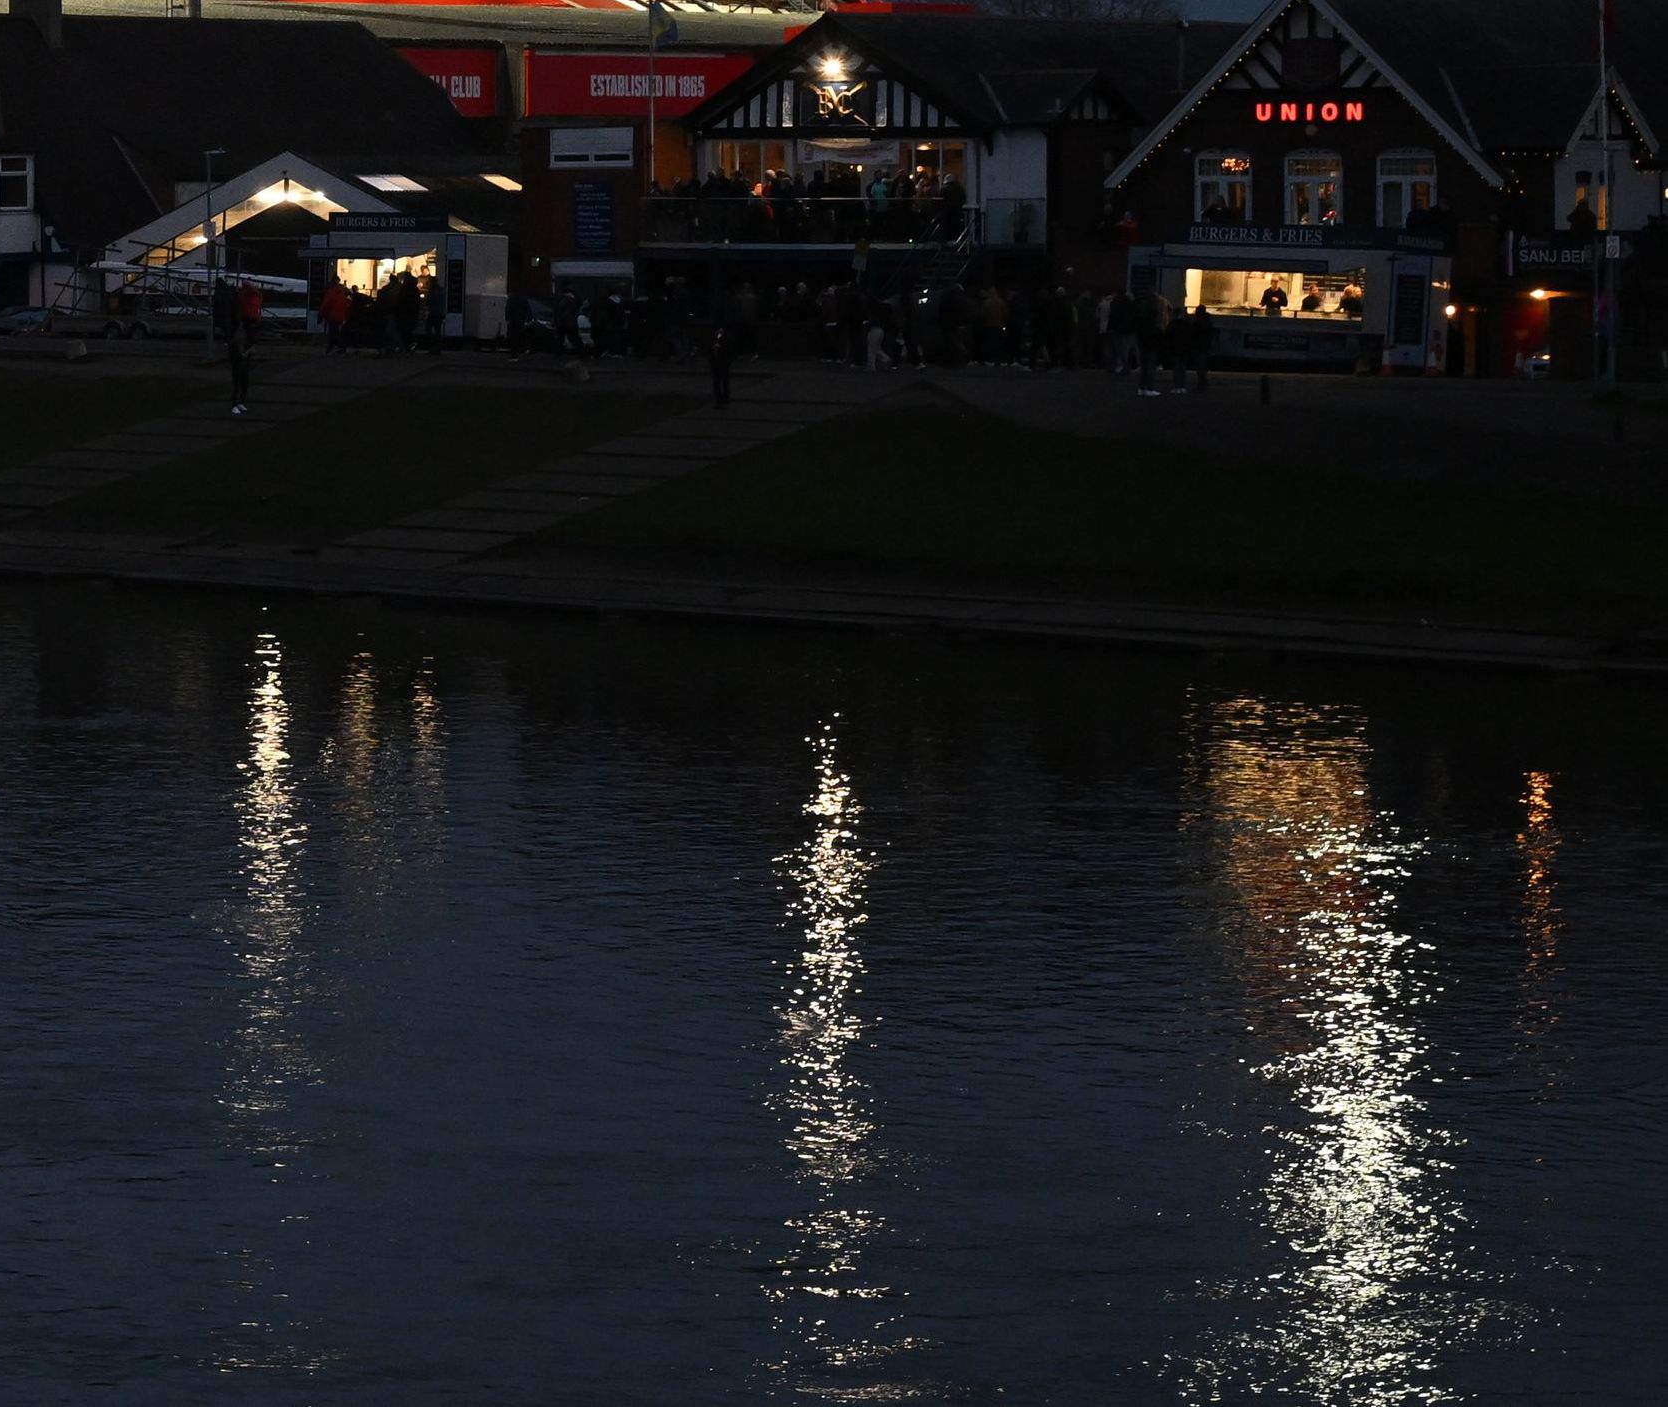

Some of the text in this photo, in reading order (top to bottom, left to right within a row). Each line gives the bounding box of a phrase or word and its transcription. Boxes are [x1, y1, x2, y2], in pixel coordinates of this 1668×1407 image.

[450, 75, 481, 98] CLUB
[665, 75, 676, 97] IN
[678, 75, 705, 98] 1865
[1255, 101, 1364, 122] UNION
[335, 216, 415, 227] BURGERS & FRIES
[1190, 226, 1323, 242] BURGERS & FRIES
[1518, 249, 1557, 264] SANJ
